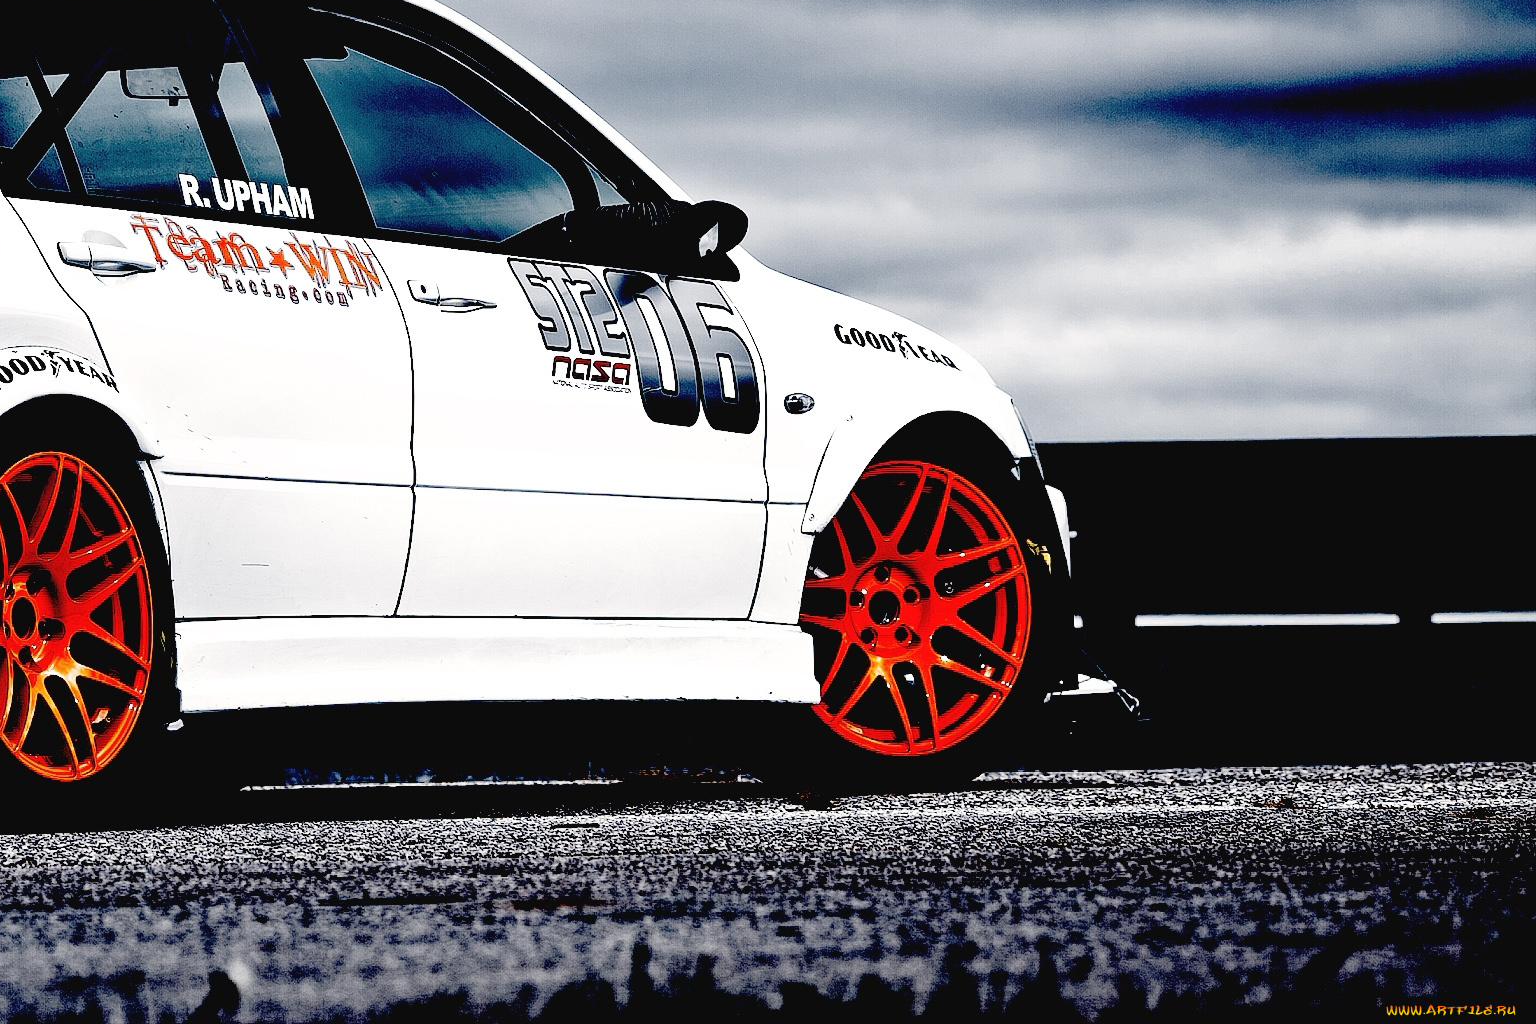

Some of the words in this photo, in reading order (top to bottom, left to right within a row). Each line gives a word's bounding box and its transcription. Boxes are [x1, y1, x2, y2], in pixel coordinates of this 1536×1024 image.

[178, 173, 212, 209] R.
[212, 177, 314, 220] UPHAM
[130, 214, 270, 277] Team
[220, 274, 350, 307] Racing.com
[603, 267, 761, 435] 06
